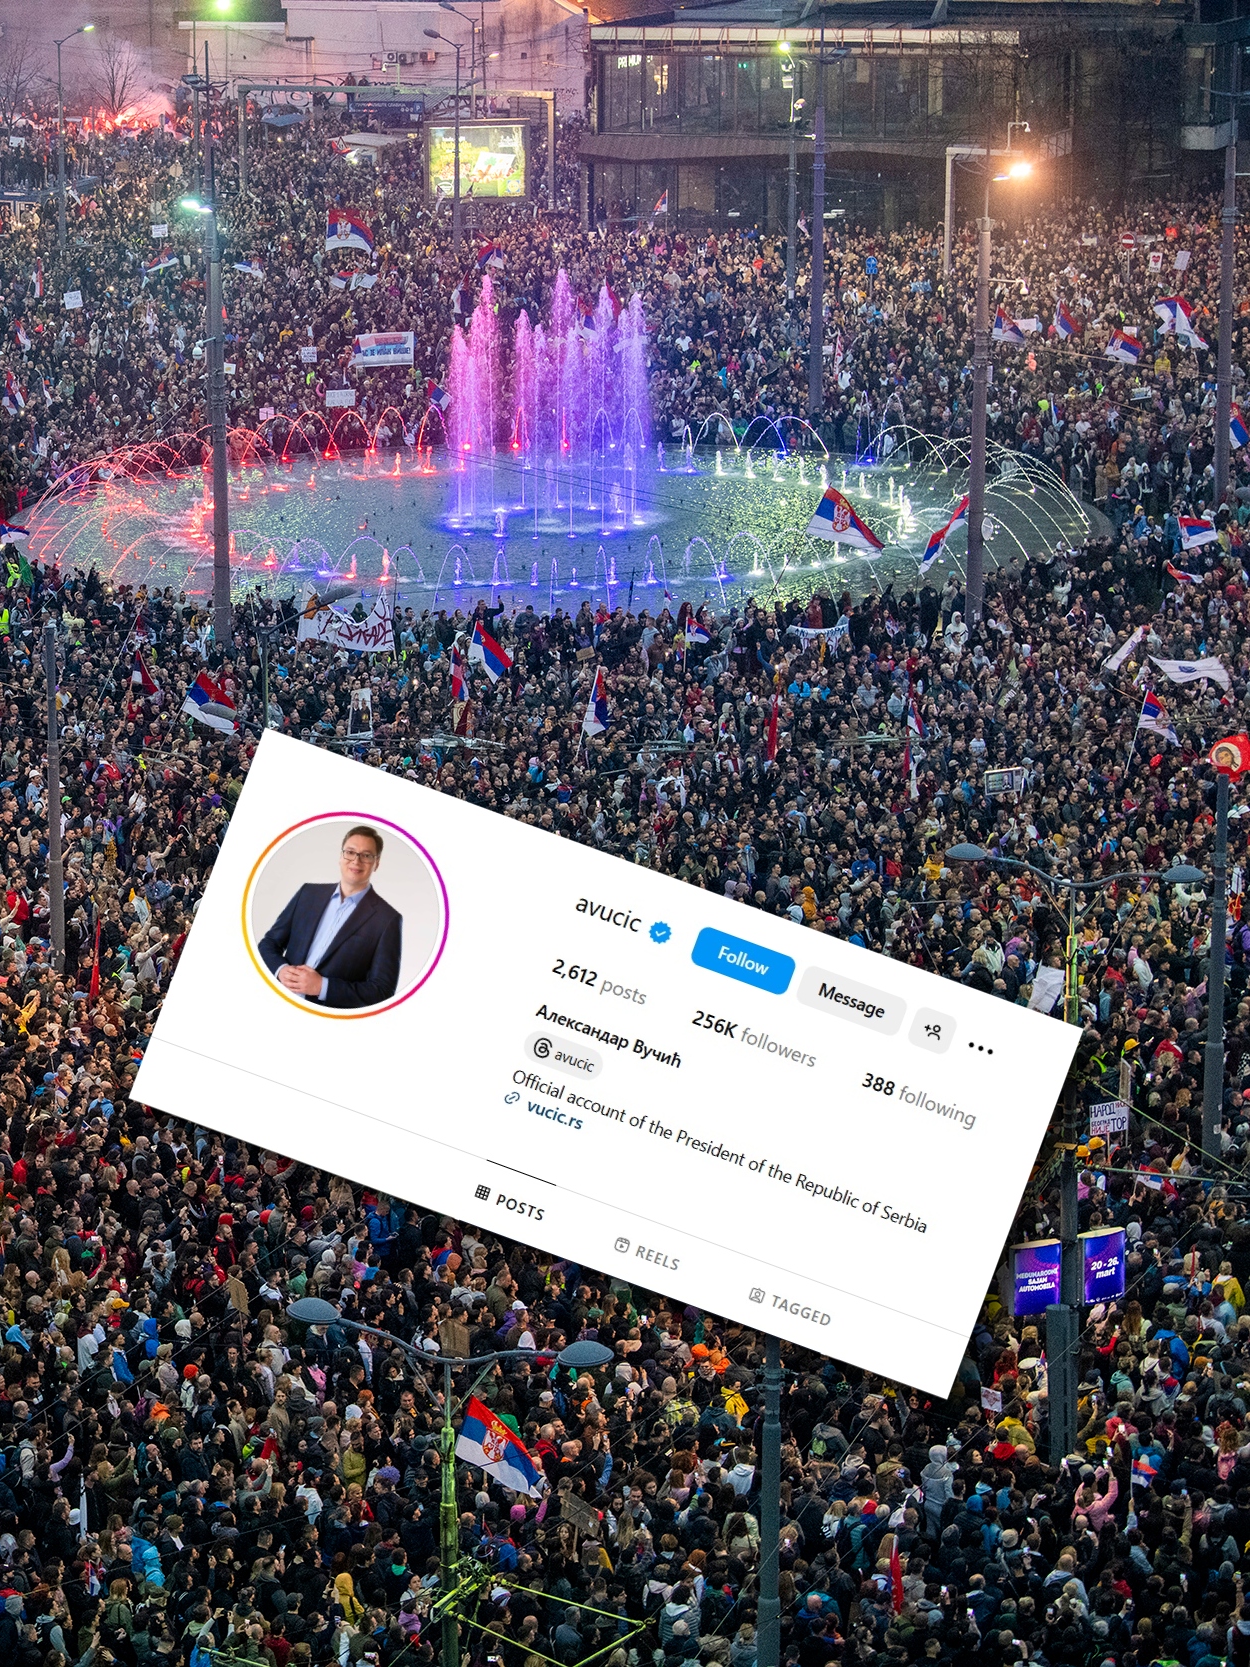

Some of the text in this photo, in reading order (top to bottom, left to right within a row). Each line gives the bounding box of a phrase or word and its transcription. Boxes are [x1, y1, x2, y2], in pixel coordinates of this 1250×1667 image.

[1090, 1103, 1116, 1118] НАРОД
[1091, 1260, 1102, 1271] 20
[1096, 1267, 1116, 1279] mart
[1018, 1281, 1056, 1293] AUTOMOBILA
